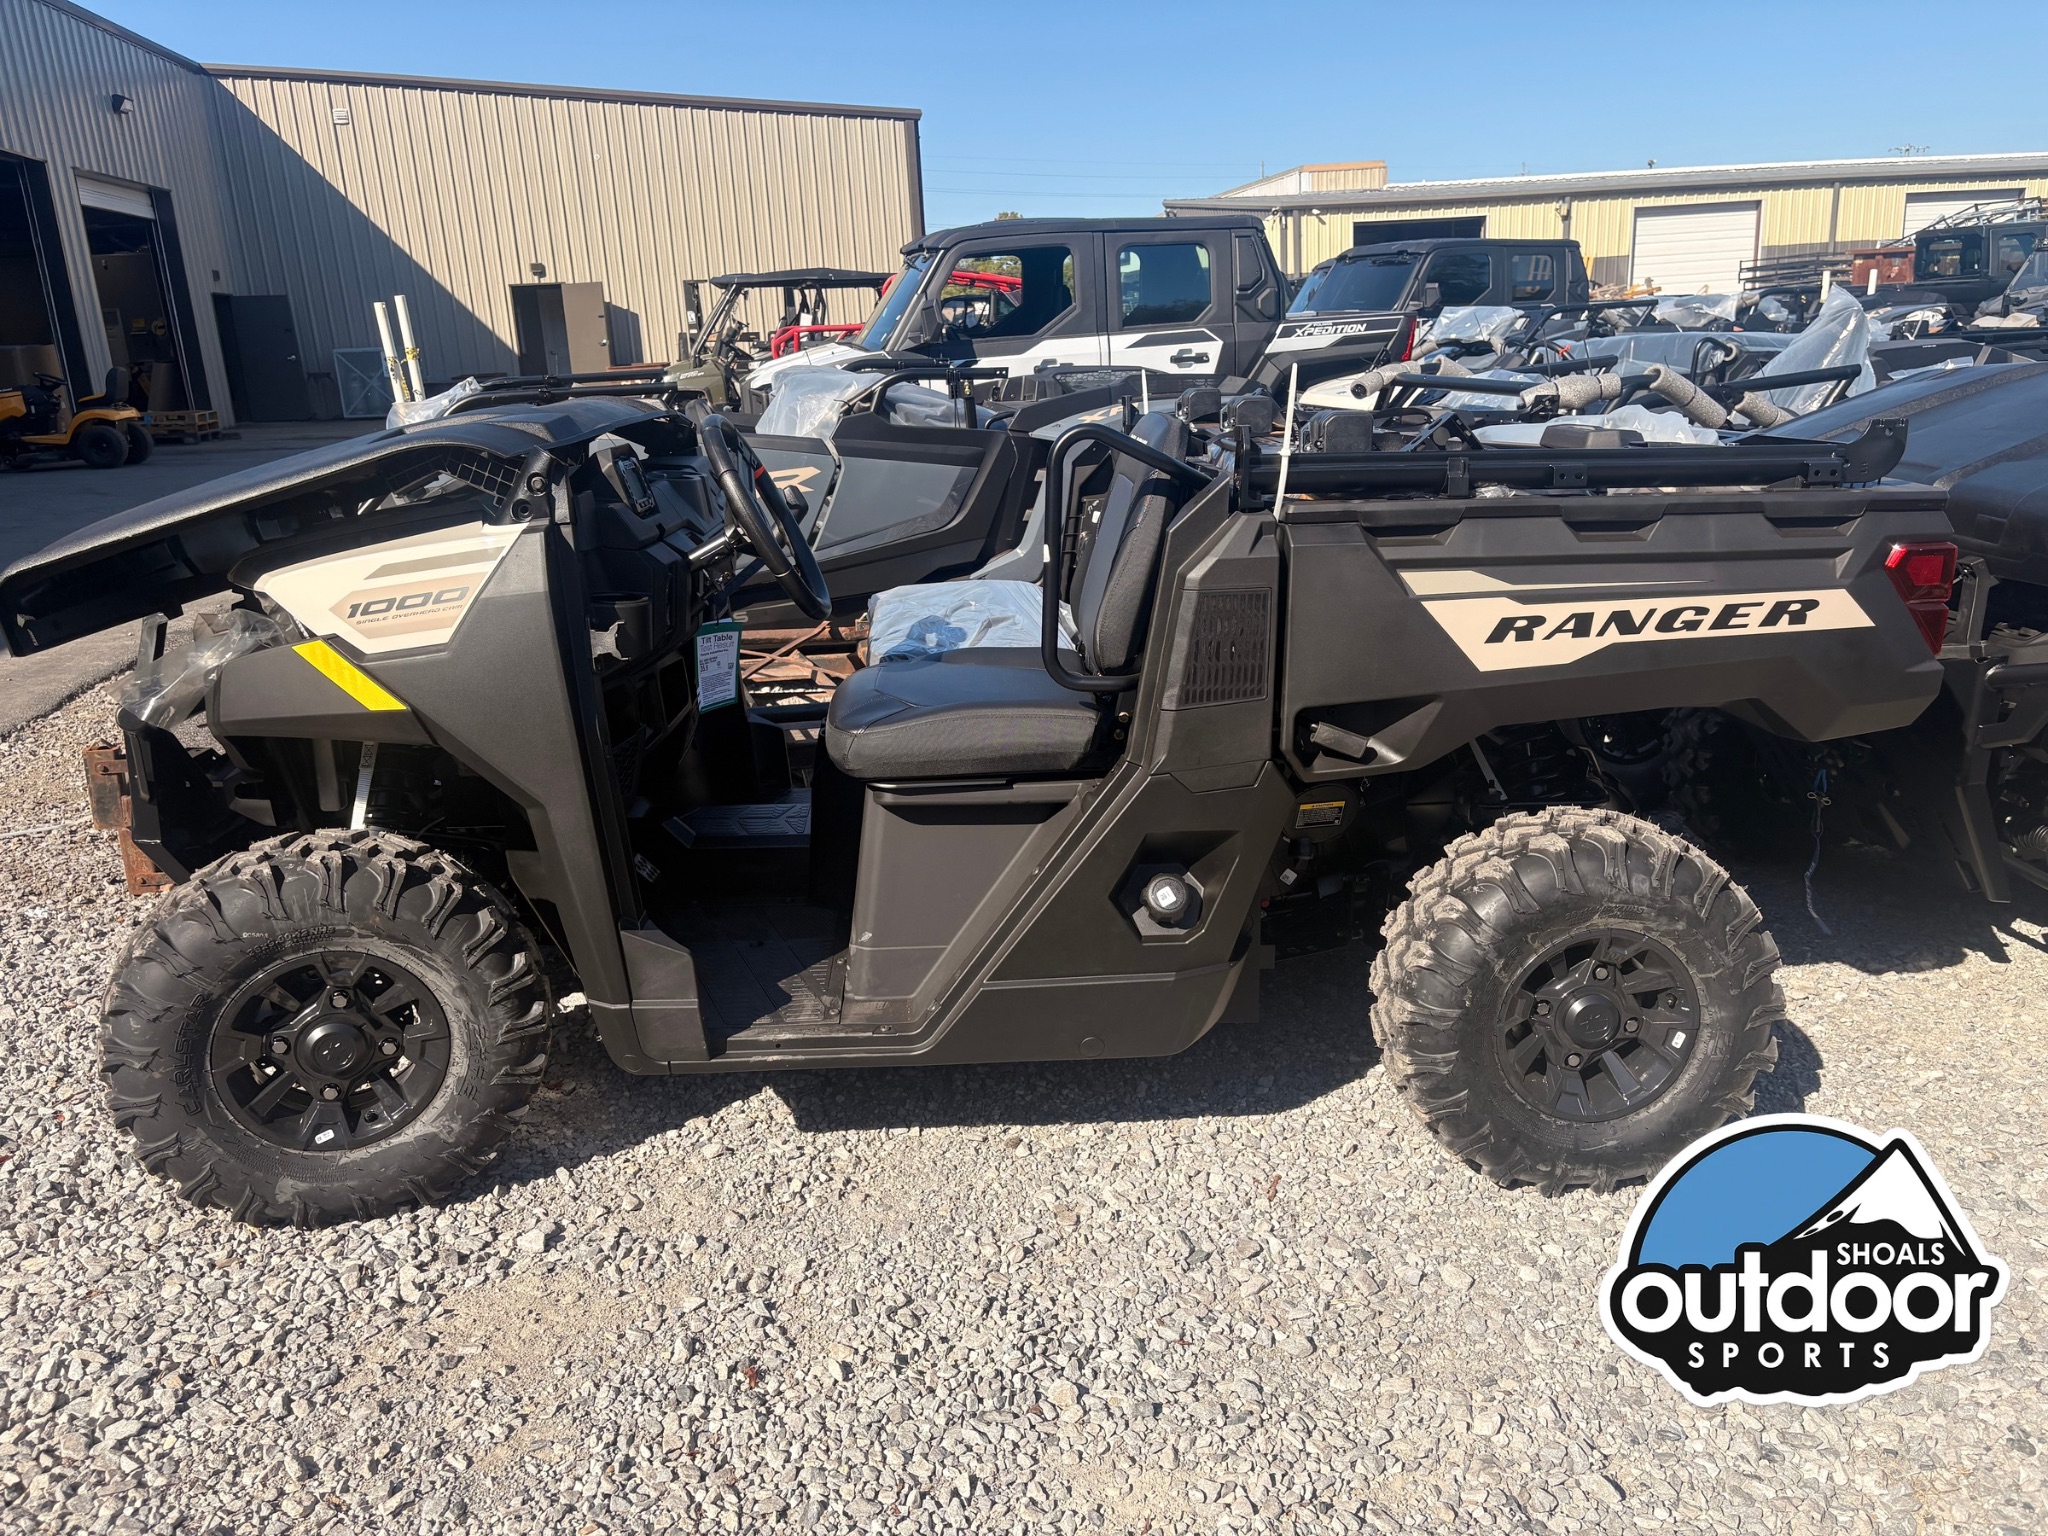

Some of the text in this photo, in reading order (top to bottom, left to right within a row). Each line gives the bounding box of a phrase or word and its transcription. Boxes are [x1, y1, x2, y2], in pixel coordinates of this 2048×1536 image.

[1291, 323, 1367, 338] XPEDITION
[347, 586, 470, 619] 1000
[355, 604, 463, 625] SINGLE OVERHEAD CAM
[1484, 599, 1820, 644] RANGER
[700, 644, 713, 653] Test
[713, 641, 735, 650] Result
[701, 633, 734, 645] Tilt Table
[174, 992, 210, 1117] CARLSTAR
